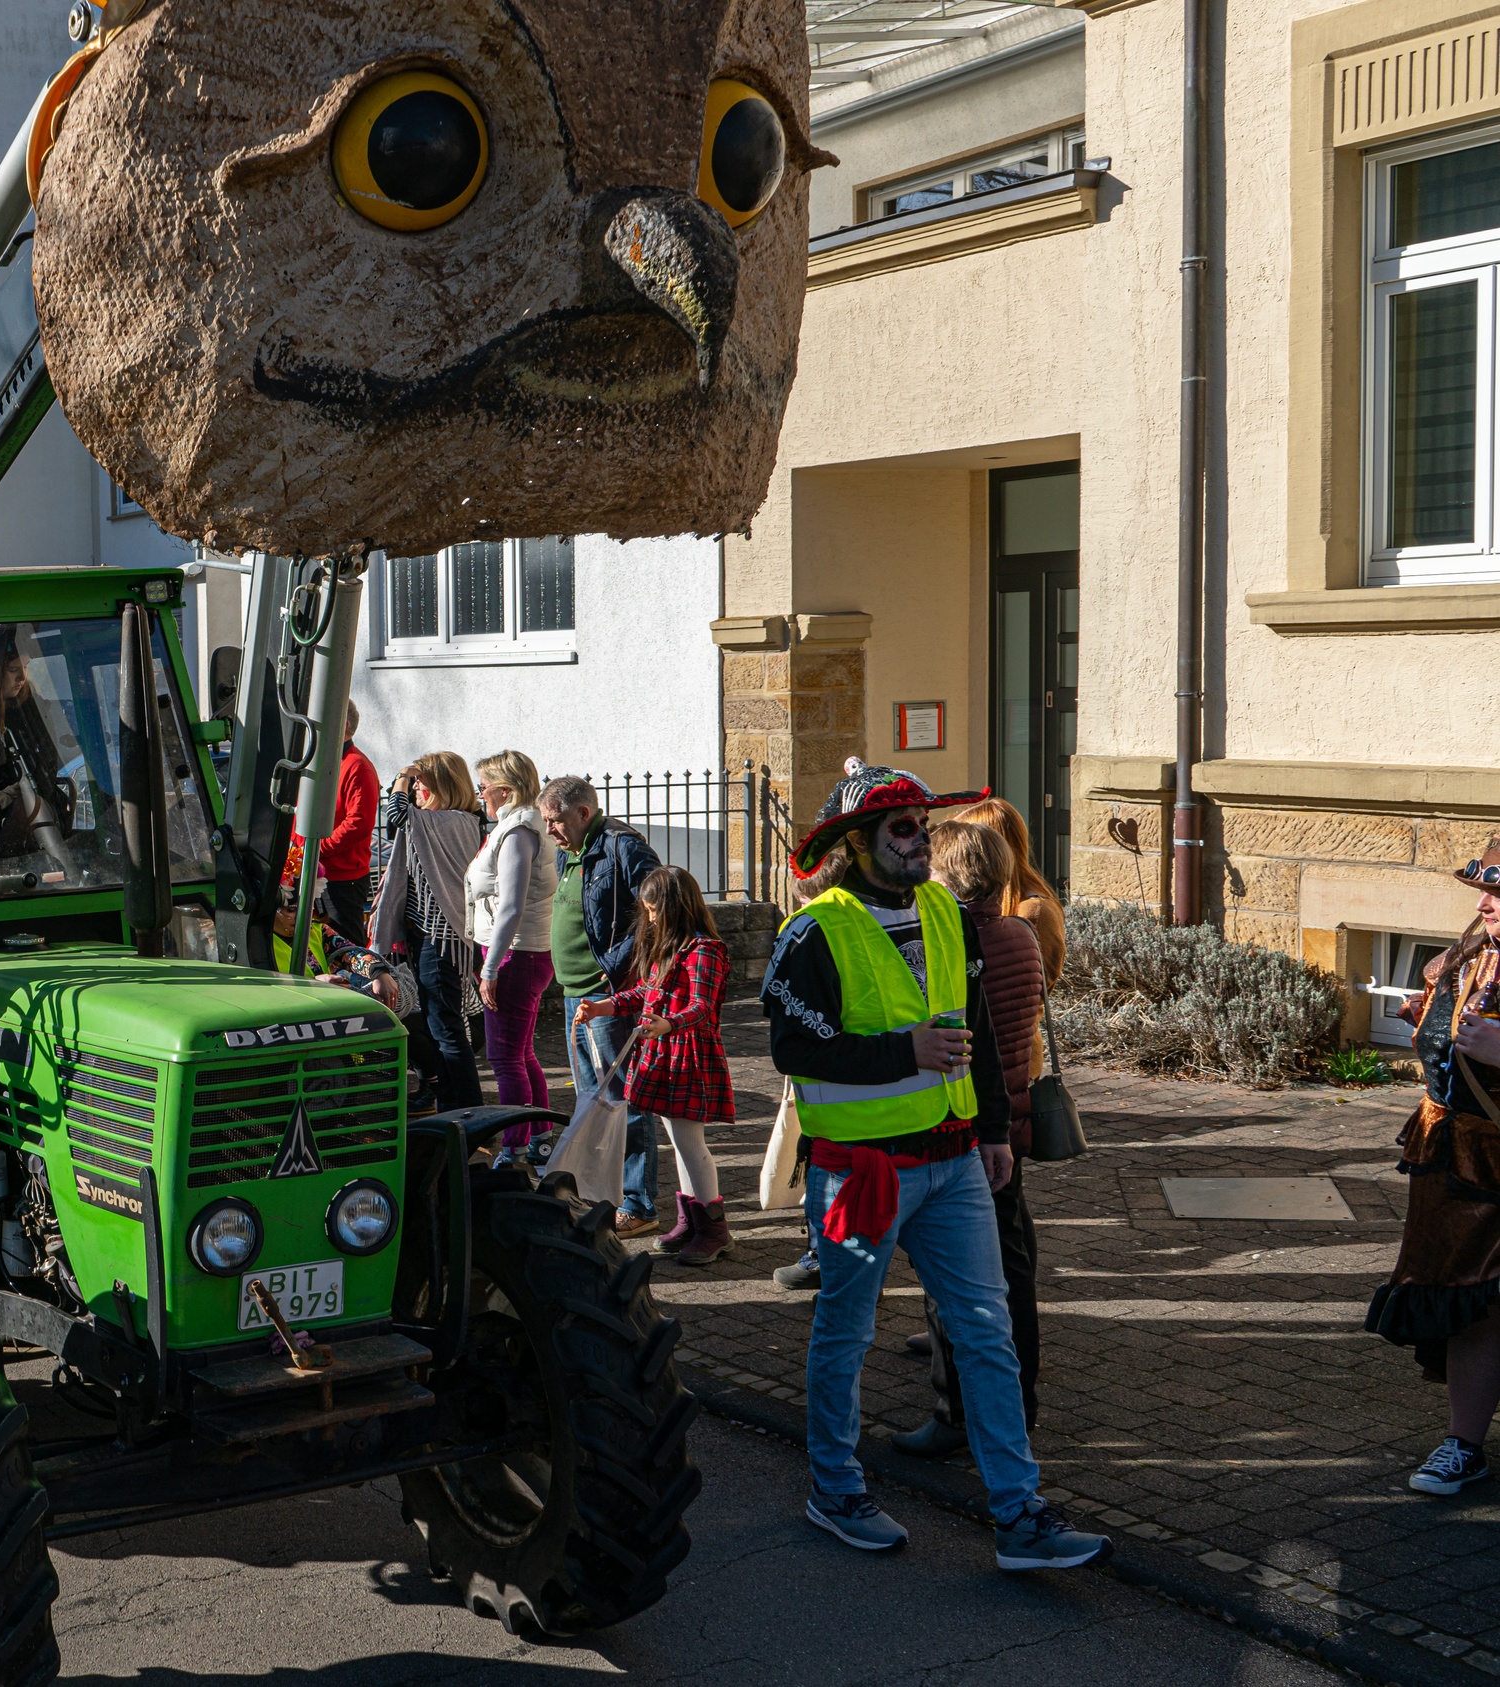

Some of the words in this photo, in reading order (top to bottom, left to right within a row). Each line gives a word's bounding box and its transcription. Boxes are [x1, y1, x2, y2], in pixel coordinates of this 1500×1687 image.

[224, 1016, 369, 1048] DEUTZ
[268, 1267, 318, 1295] BIT
[289, 1291, 338, 1318] 979
